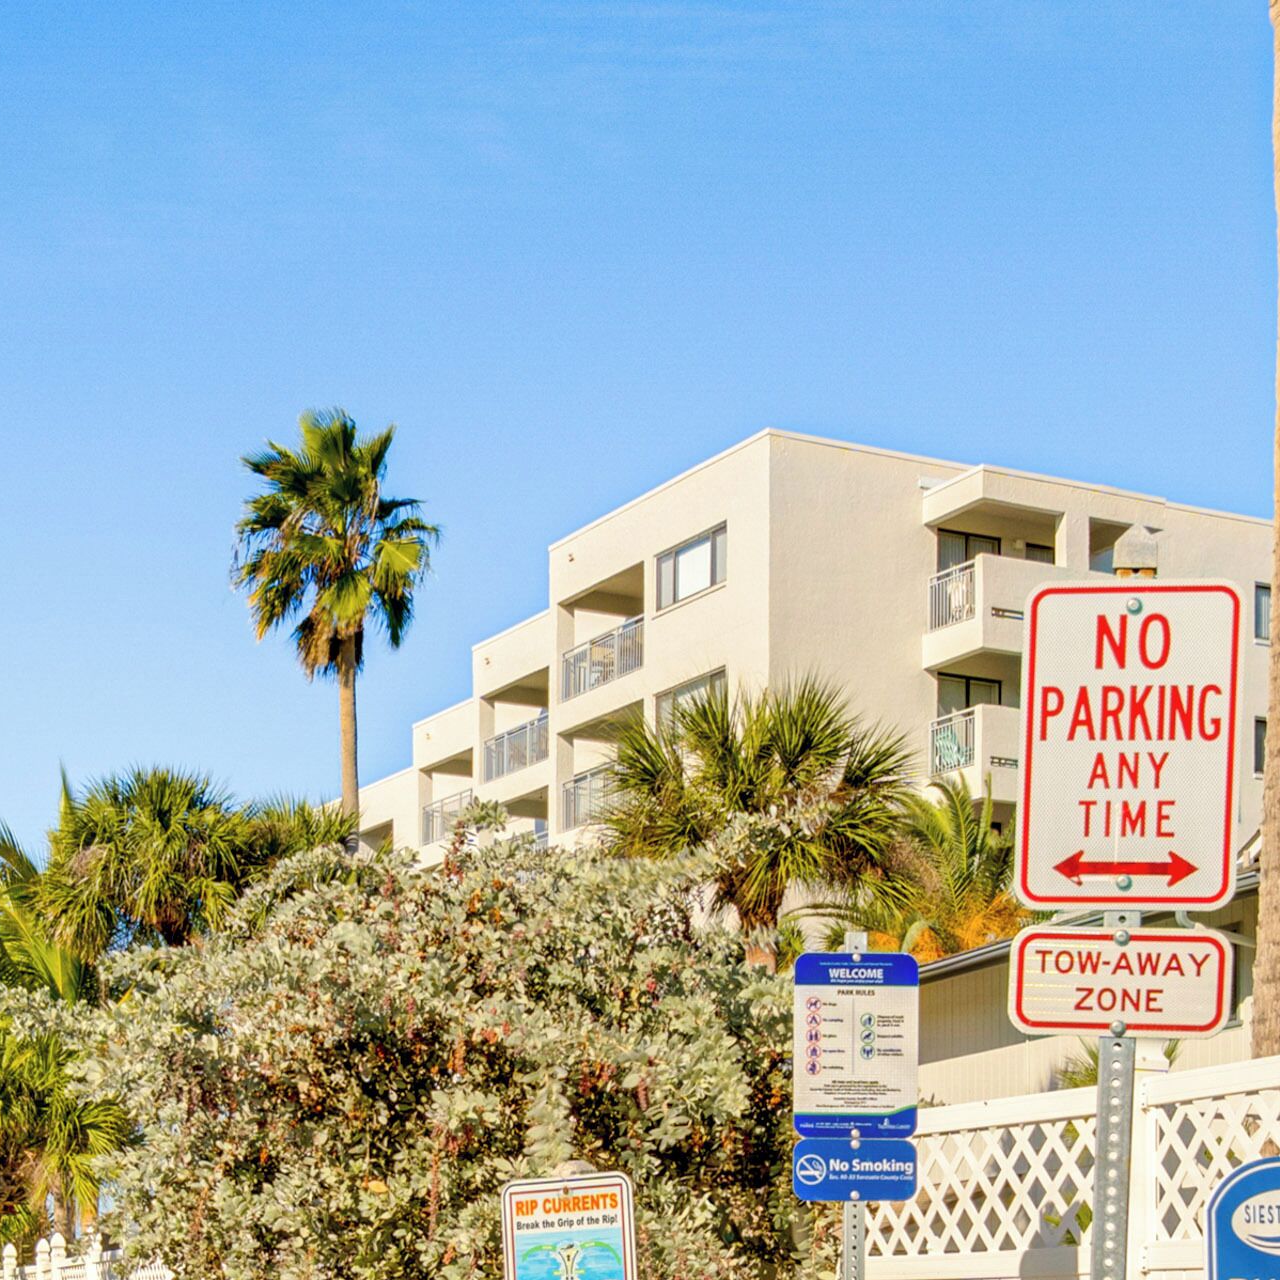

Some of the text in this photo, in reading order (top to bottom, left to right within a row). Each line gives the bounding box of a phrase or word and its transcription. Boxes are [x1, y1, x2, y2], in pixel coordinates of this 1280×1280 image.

[1095, 613, 1171, 669] NO
[1040, 684, 1223, 742] PARKING
[1087, 751, 1170, 790] ANY
[1078, 800, 1176, 838] TIME
[828, 968, 884, 979] WELCOME
[1035, 950, 1211, 977] TOW-AWAY
[1074, 987, 1164, 1012] ZONE
[829, 1158, 914, 1174] No Smoking
[515, 1193, 618, 1216] RIP CURRENTS
[516, 1213, 618, 1230] Break the Grip of the Rip!
